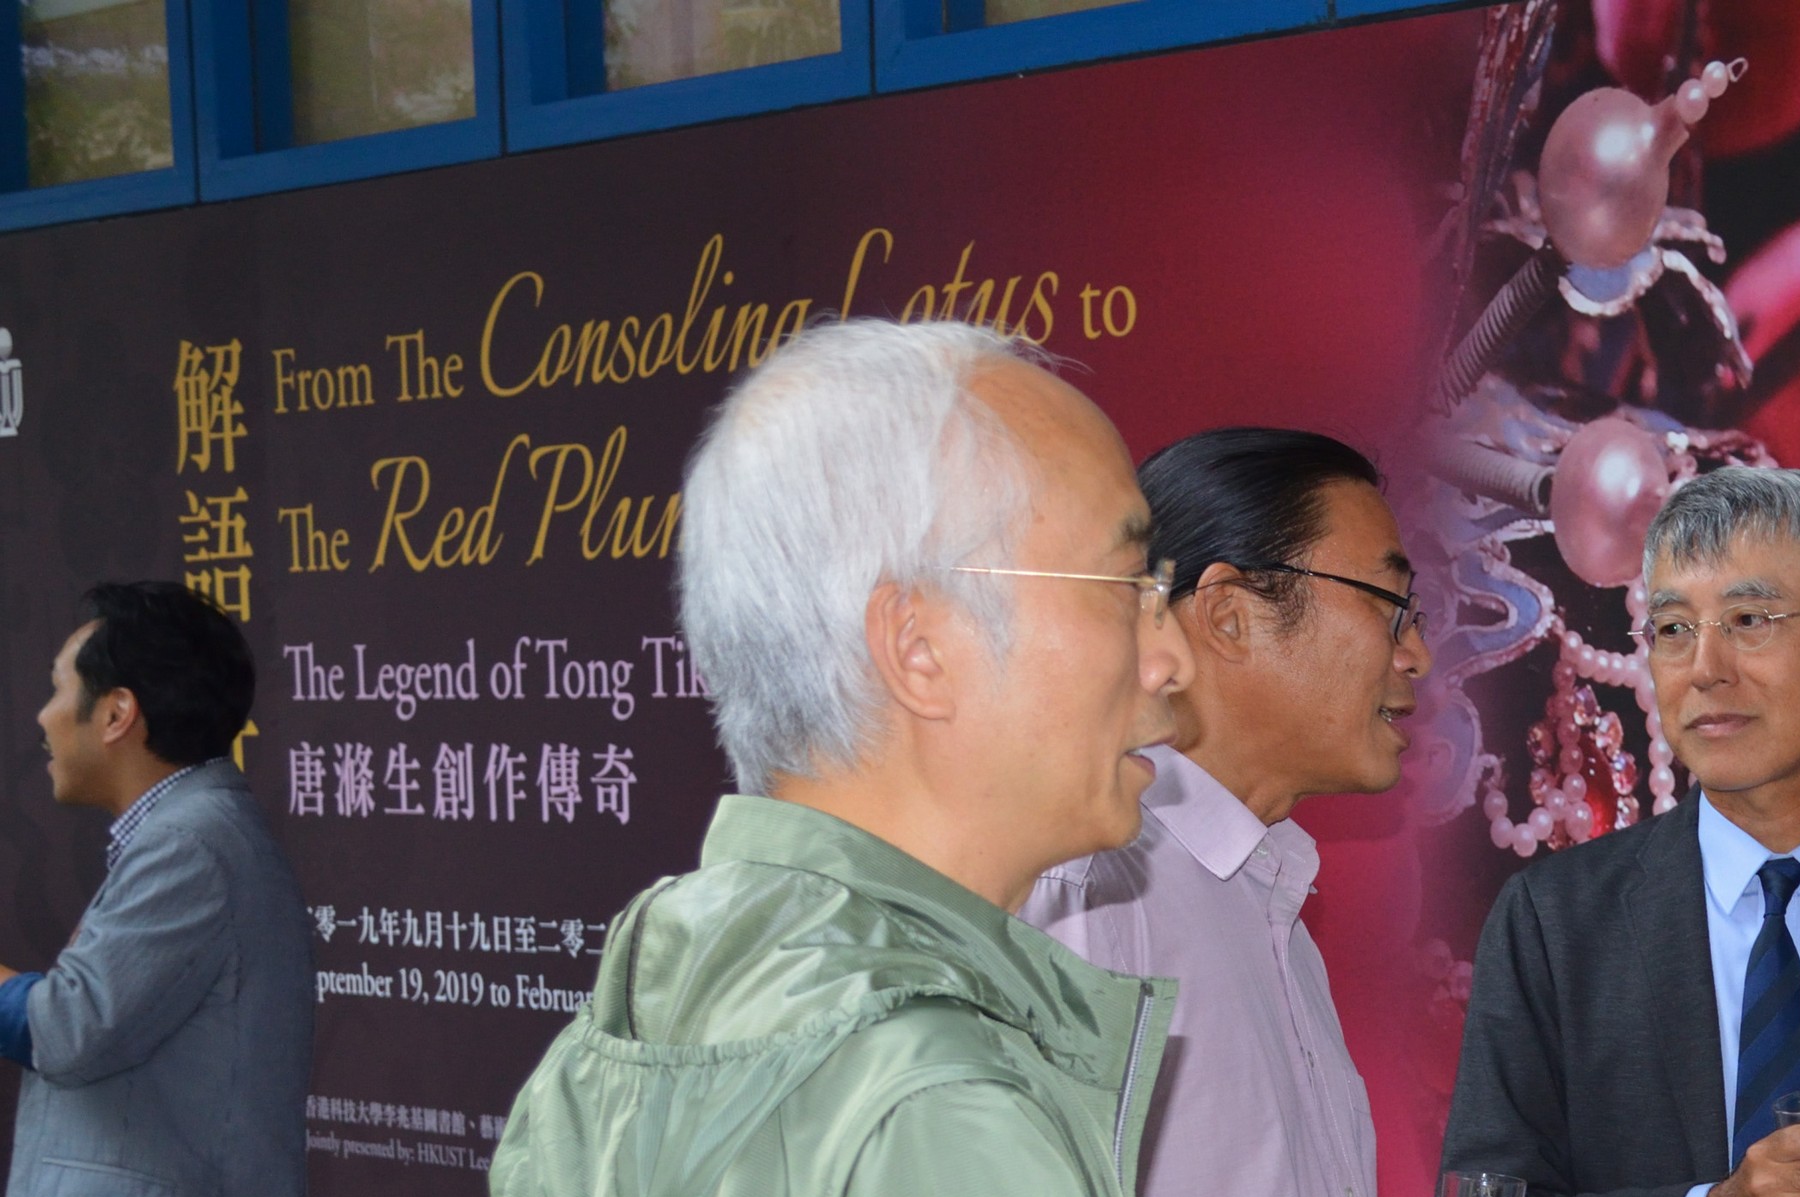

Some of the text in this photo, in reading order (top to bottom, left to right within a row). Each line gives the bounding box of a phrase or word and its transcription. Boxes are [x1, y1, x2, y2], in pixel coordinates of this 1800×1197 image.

[273, 348, 374, 415] From
[386, 328, 465, 403] The
[1079, 282, 1138, 341] to
[279, 503, 351, 573] The
[370, 433, 531, 574] Red
[283, 642, 346, 702] The
[353, 640, 480, 721] Legend
[489, 636, 531, 699] of
[535, 638, 636, 721] Tong
[289, 742, 638, 826] 唐滌生創作傳奇
[306, 905, 607, 958] 零一九年九月十九日至二零二
[398, 967, 430, 1005] 19,
[433, 969, 484, 1007] 2019
[490, 981, 511, 1008] to
[343, 1138, 395, 1160] presented
[417, 1141, 467, 1169] HKUST
